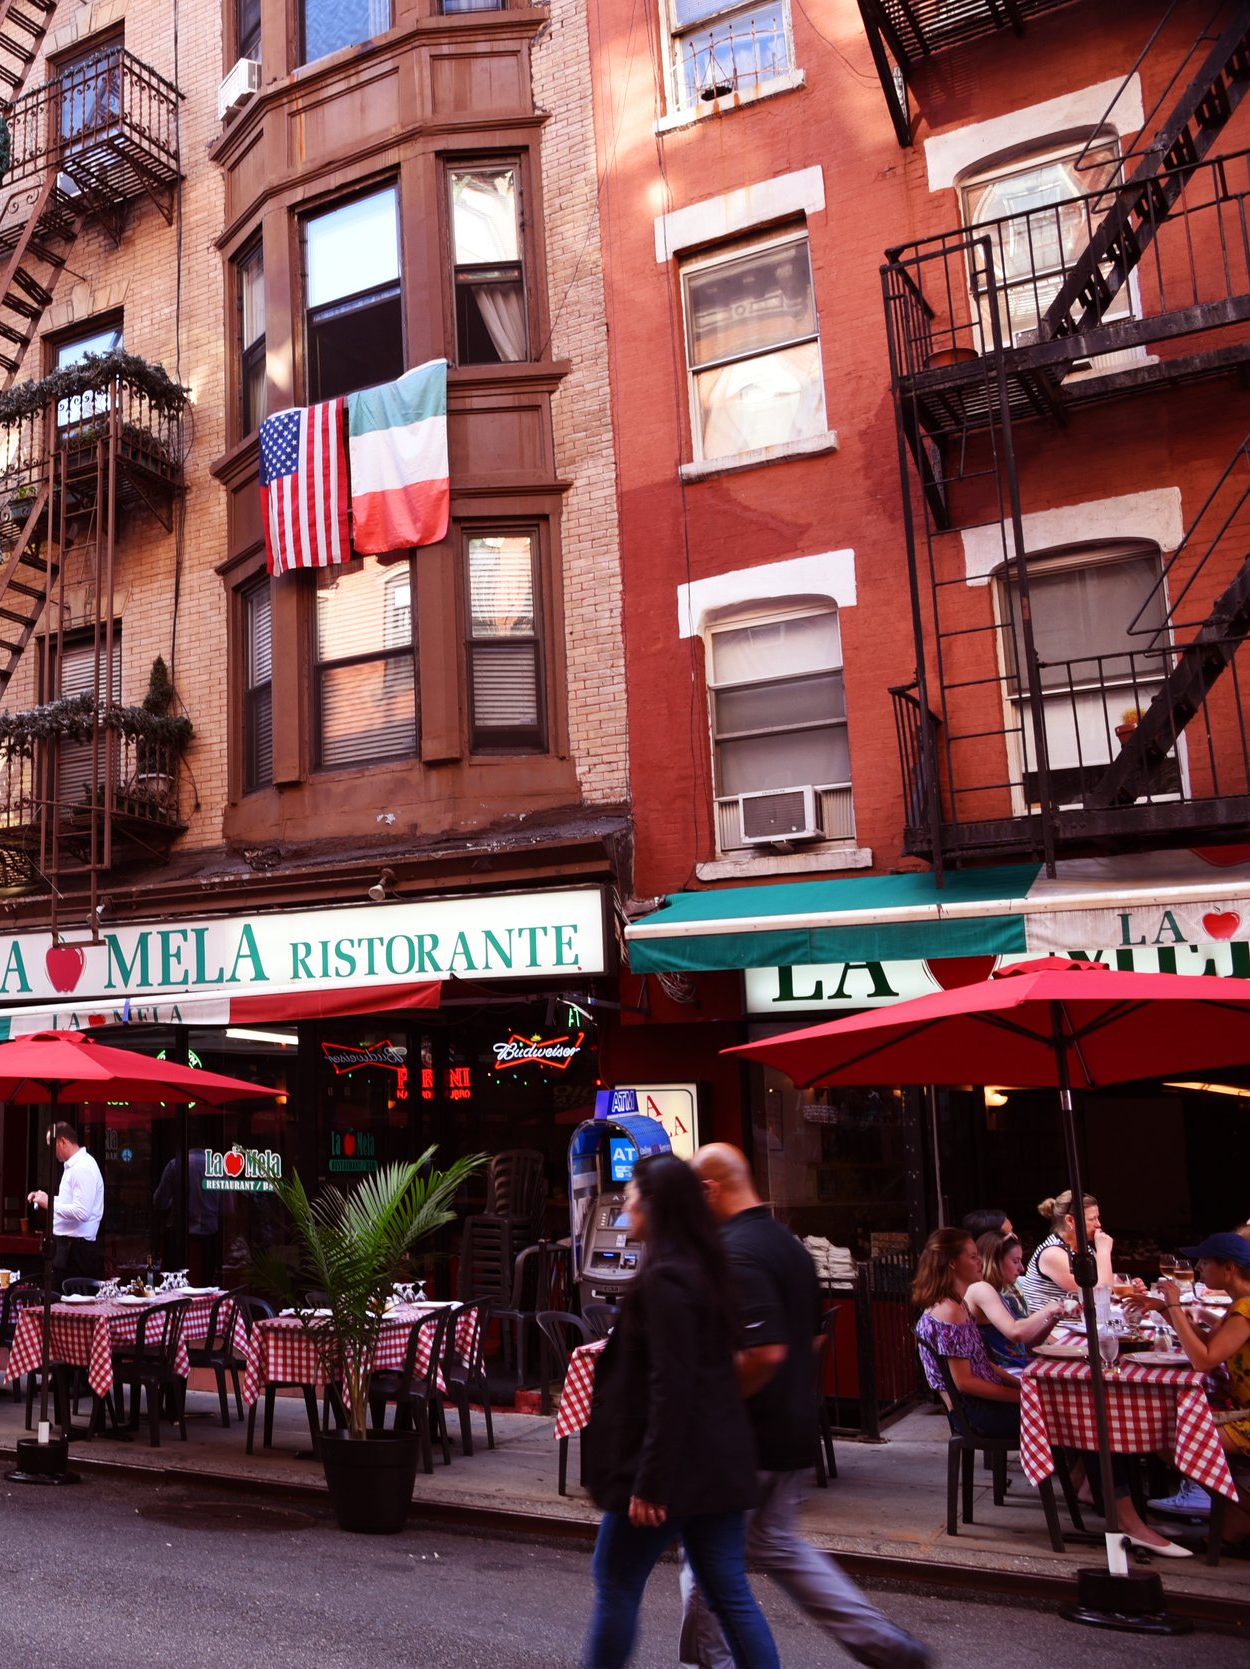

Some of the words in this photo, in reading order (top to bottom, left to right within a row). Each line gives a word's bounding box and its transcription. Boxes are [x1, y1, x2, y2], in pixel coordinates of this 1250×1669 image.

[1117, 910, 1188, 946] LA
[104, 923, 270, 988] MELA
[289, 924, 580, 980] RISTORANTE
[493, 1042, 581, 1061] Budweiser
[397, 1067, 471, 1088] PRNI
[611, 1091, 635, 1113] ATM
[205, 1149, 223, 1177] La
[245, 1149, 281, 1178] Mela
[206, 1180, 255, 1191] RESTAURANT
